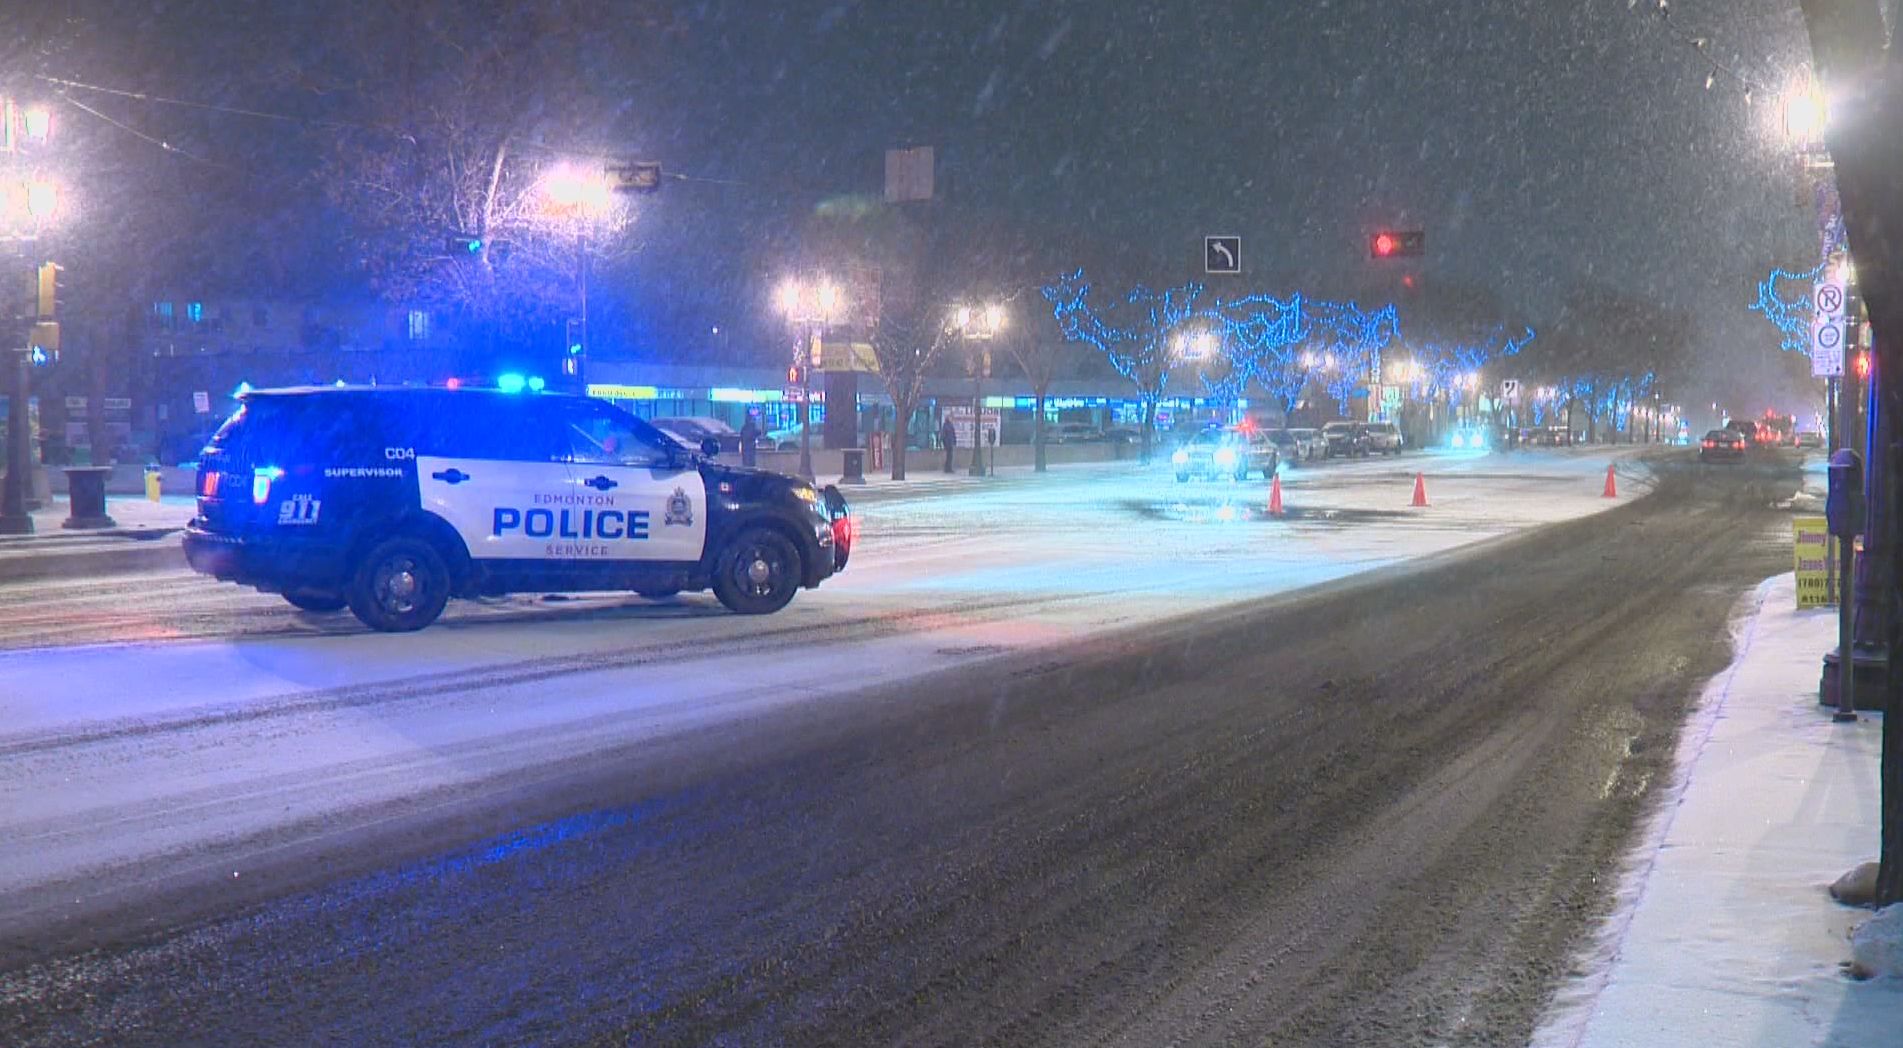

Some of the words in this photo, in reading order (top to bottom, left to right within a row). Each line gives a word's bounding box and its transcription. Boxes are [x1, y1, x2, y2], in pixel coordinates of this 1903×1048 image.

[324, 468, 404, 478] SUPERVISOR
[534, 494, 614, 507] EDMONTON
[279, 500, 321, 519] 911
[493, 507, 650, 540] POLICE
[546, 545, 609, 556] SERVICE
